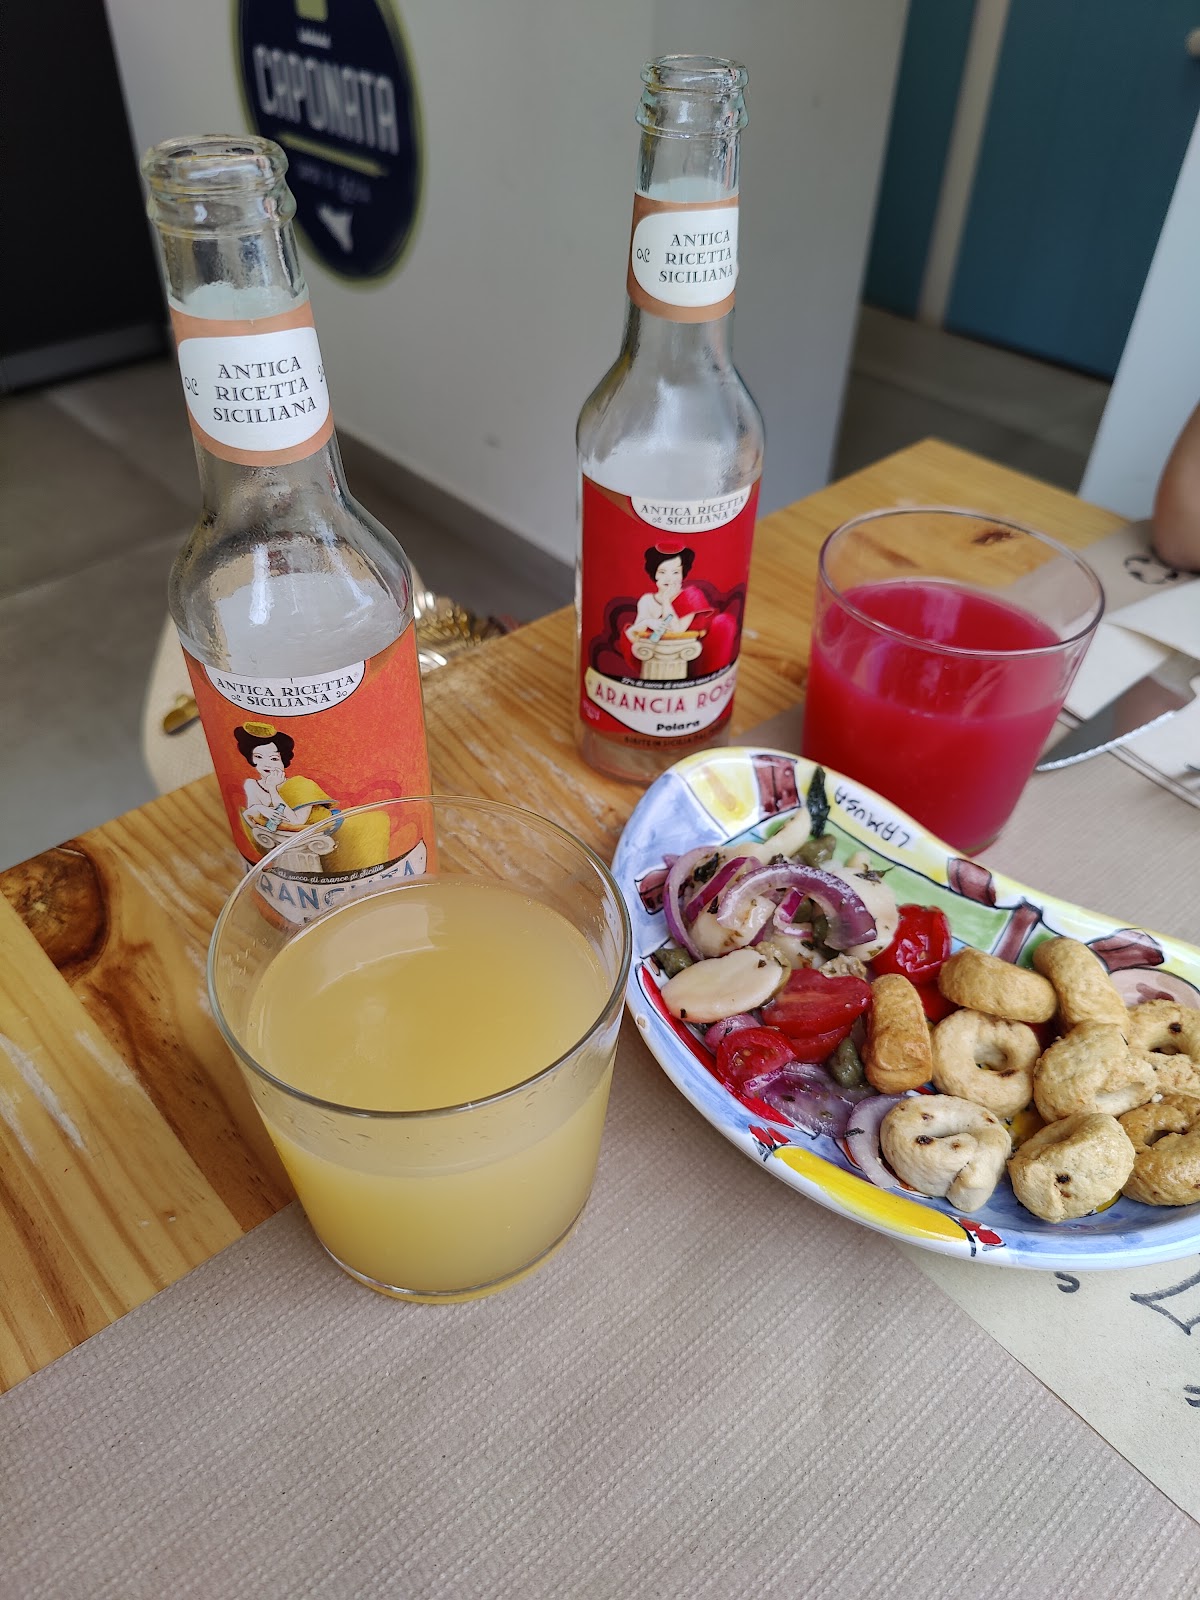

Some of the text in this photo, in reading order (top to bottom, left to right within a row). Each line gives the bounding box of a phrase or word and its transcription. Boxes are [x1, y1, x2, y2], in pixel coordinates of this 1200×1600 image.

[254, 45, 398, 155] CAPONATA
[670, 230, 731, 246] ANTICA
[665, 248, 732, 265] RICETTA
[659, 264, 733, 284] SICILIANA
[218, 356, 302, 379] ANTICA
[214, 377, 310, 401] RICETTA
[213, 397, 317, 423] SICILIANA
[641, 495, 744, 516] ANTICA RICETTA
[666, 511, 728, 526] SICILIANA
[216, 676, 356, 697] ANTICA RICETTA
[247, 693, 331, 708] SICILIANA
[595, 682, 685, 714] ARANCIA
[656, 720, 700, 732] Polara
[288, 874, 308, 882] succo
